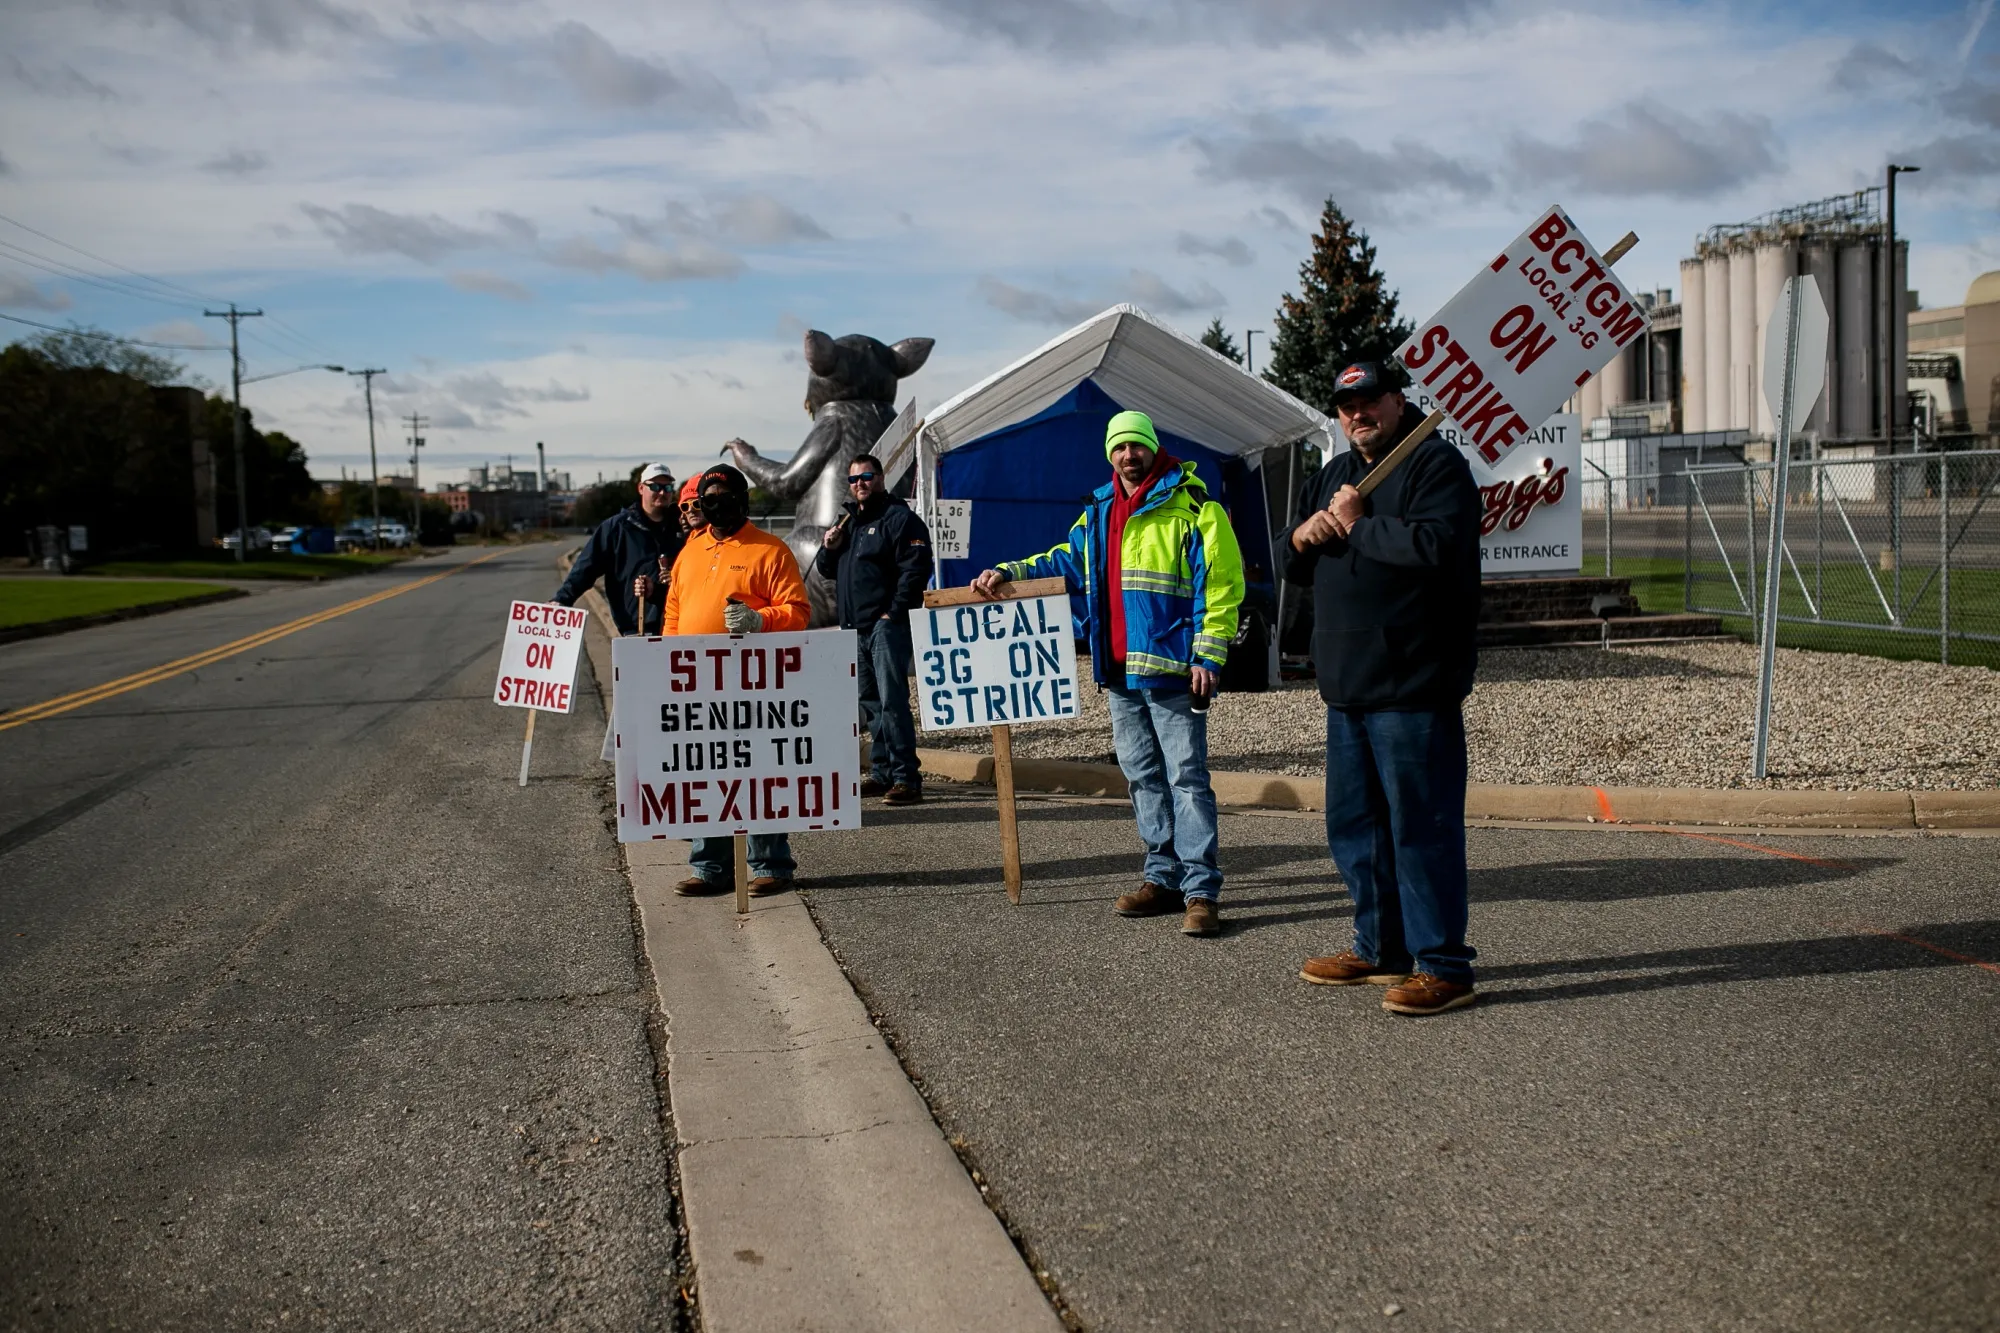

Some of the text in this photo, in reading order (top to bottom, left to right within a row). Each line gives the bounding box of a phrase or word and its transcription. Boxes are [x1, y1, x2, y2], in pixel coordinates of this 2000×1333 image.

[1528, 212, 1645, 347] BCTGM
[1519, 256, 1599, 350] LOCAL 3-G
[1490, 304, 1558, 375] ON
[1404, 325, 1530, 464] STRIKE
[1522, 426, 1567, 444] ANT
[949, 506, 963, 517] 3G
[1480, 457, 1569, 535] gg's
[1494, 544, 1569, 560] ENTRANCE
[512, 603, 584, 629] BCTGM
[518, 625, 571, 640] LOCAL 3-G
[929, 599, 1060, 646] LOCAL
[526, 642, 555, 670] ON
[670, 646, 801, 692] STOP
[923, 639, 1061, 687] 3G ON
[498, 676, 570, 709] STRIKE
[932, 678, 1073, 726] STRIKE
[661, 700, 809, 732] SENDING
[662, 736, 813, 772] JOBS TO
[641, 771, 840, 826] MEXICO!
